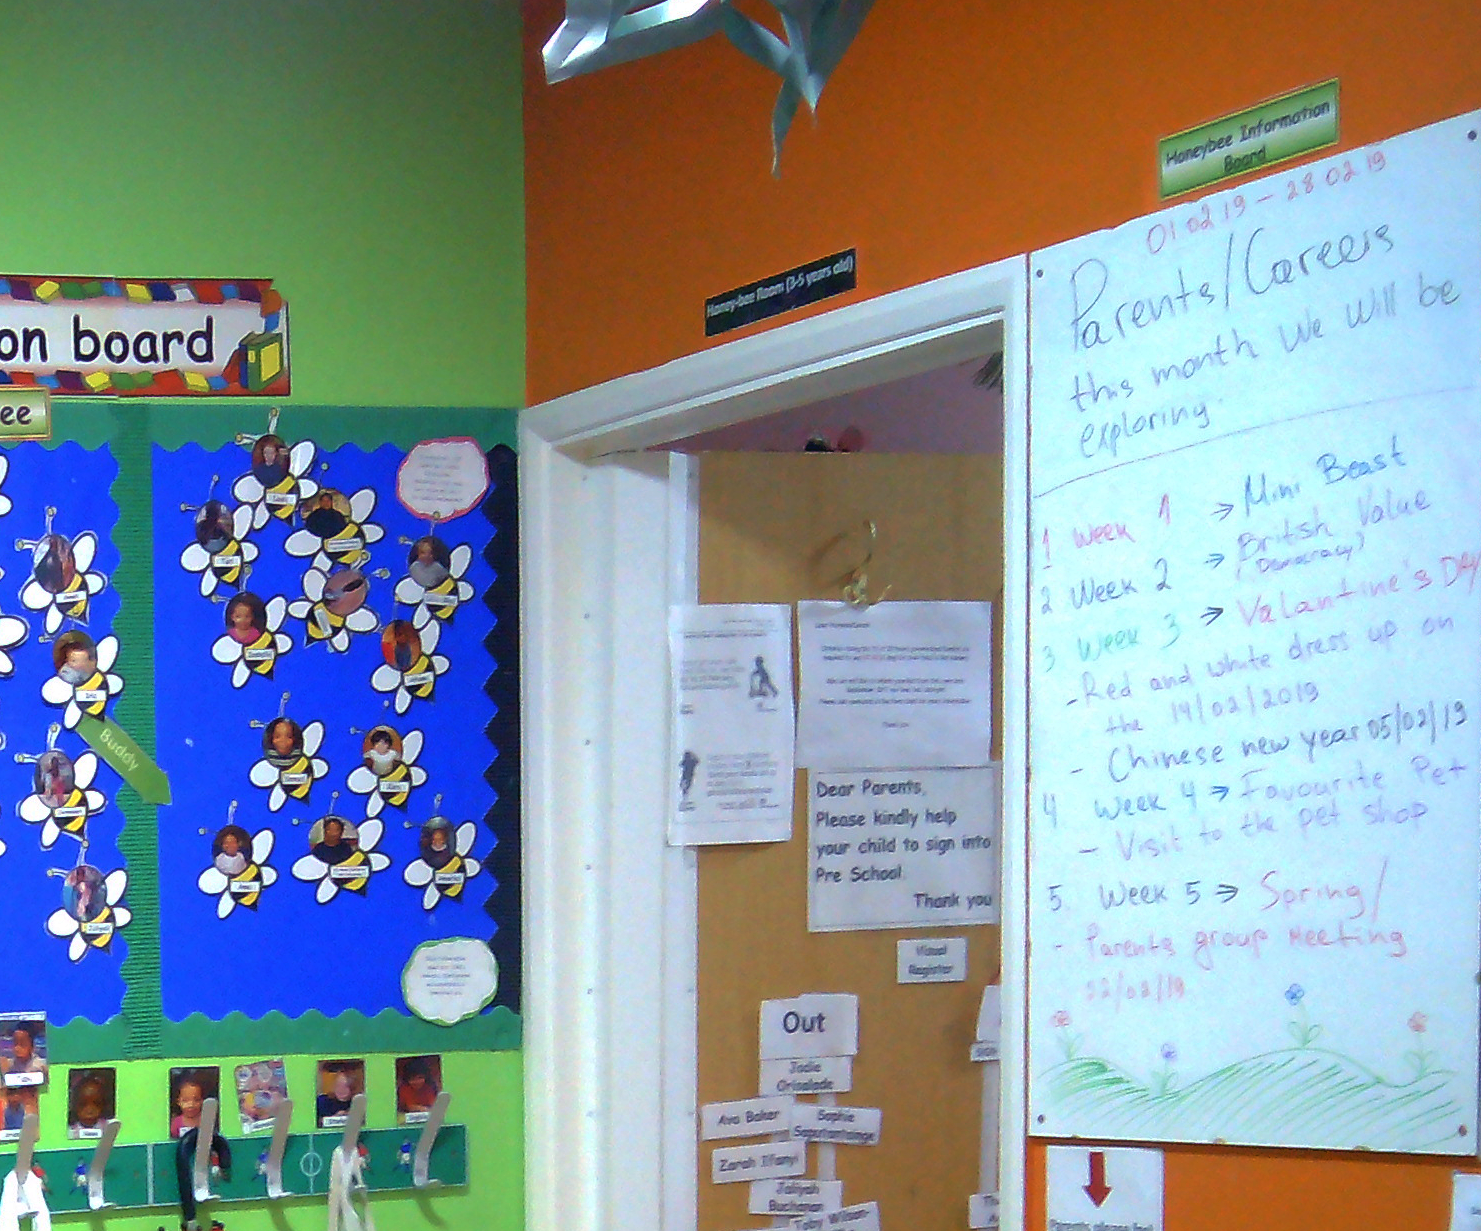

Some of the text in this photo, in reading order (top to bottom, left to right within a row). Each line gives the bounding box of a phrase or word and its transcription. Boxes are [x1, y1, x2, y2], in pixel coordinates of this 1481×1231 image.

[1165, 99, 1331, 167] Honeybee Information
[1223, 146, 1267, 174] Board
[72, 314, 215, 364] board
[1152, 329, 1257, 386] month
[1419, 272, 1460, 307] be
[1080, 401, 1210, 459] exploring
[1149, 663, 1193, 692] and
[1288, 630, 1351, 662] dress
[1421, 615, 1455, 638] on
[99, 727, 139, 770] Buddy
[1107, 741, 1225, 784] Chinese
[816, 780, 855, 798] Dear
[815, 808, 957, 828] Please kindly help
[815, 834, 992, 860] your child to sign into
[815, 867, 842, 882] Pre
[913, 893, 993, 911] Thank you
[1183, 879, 1203, 909] 5
[782, 1011, 827, 1034] Out
